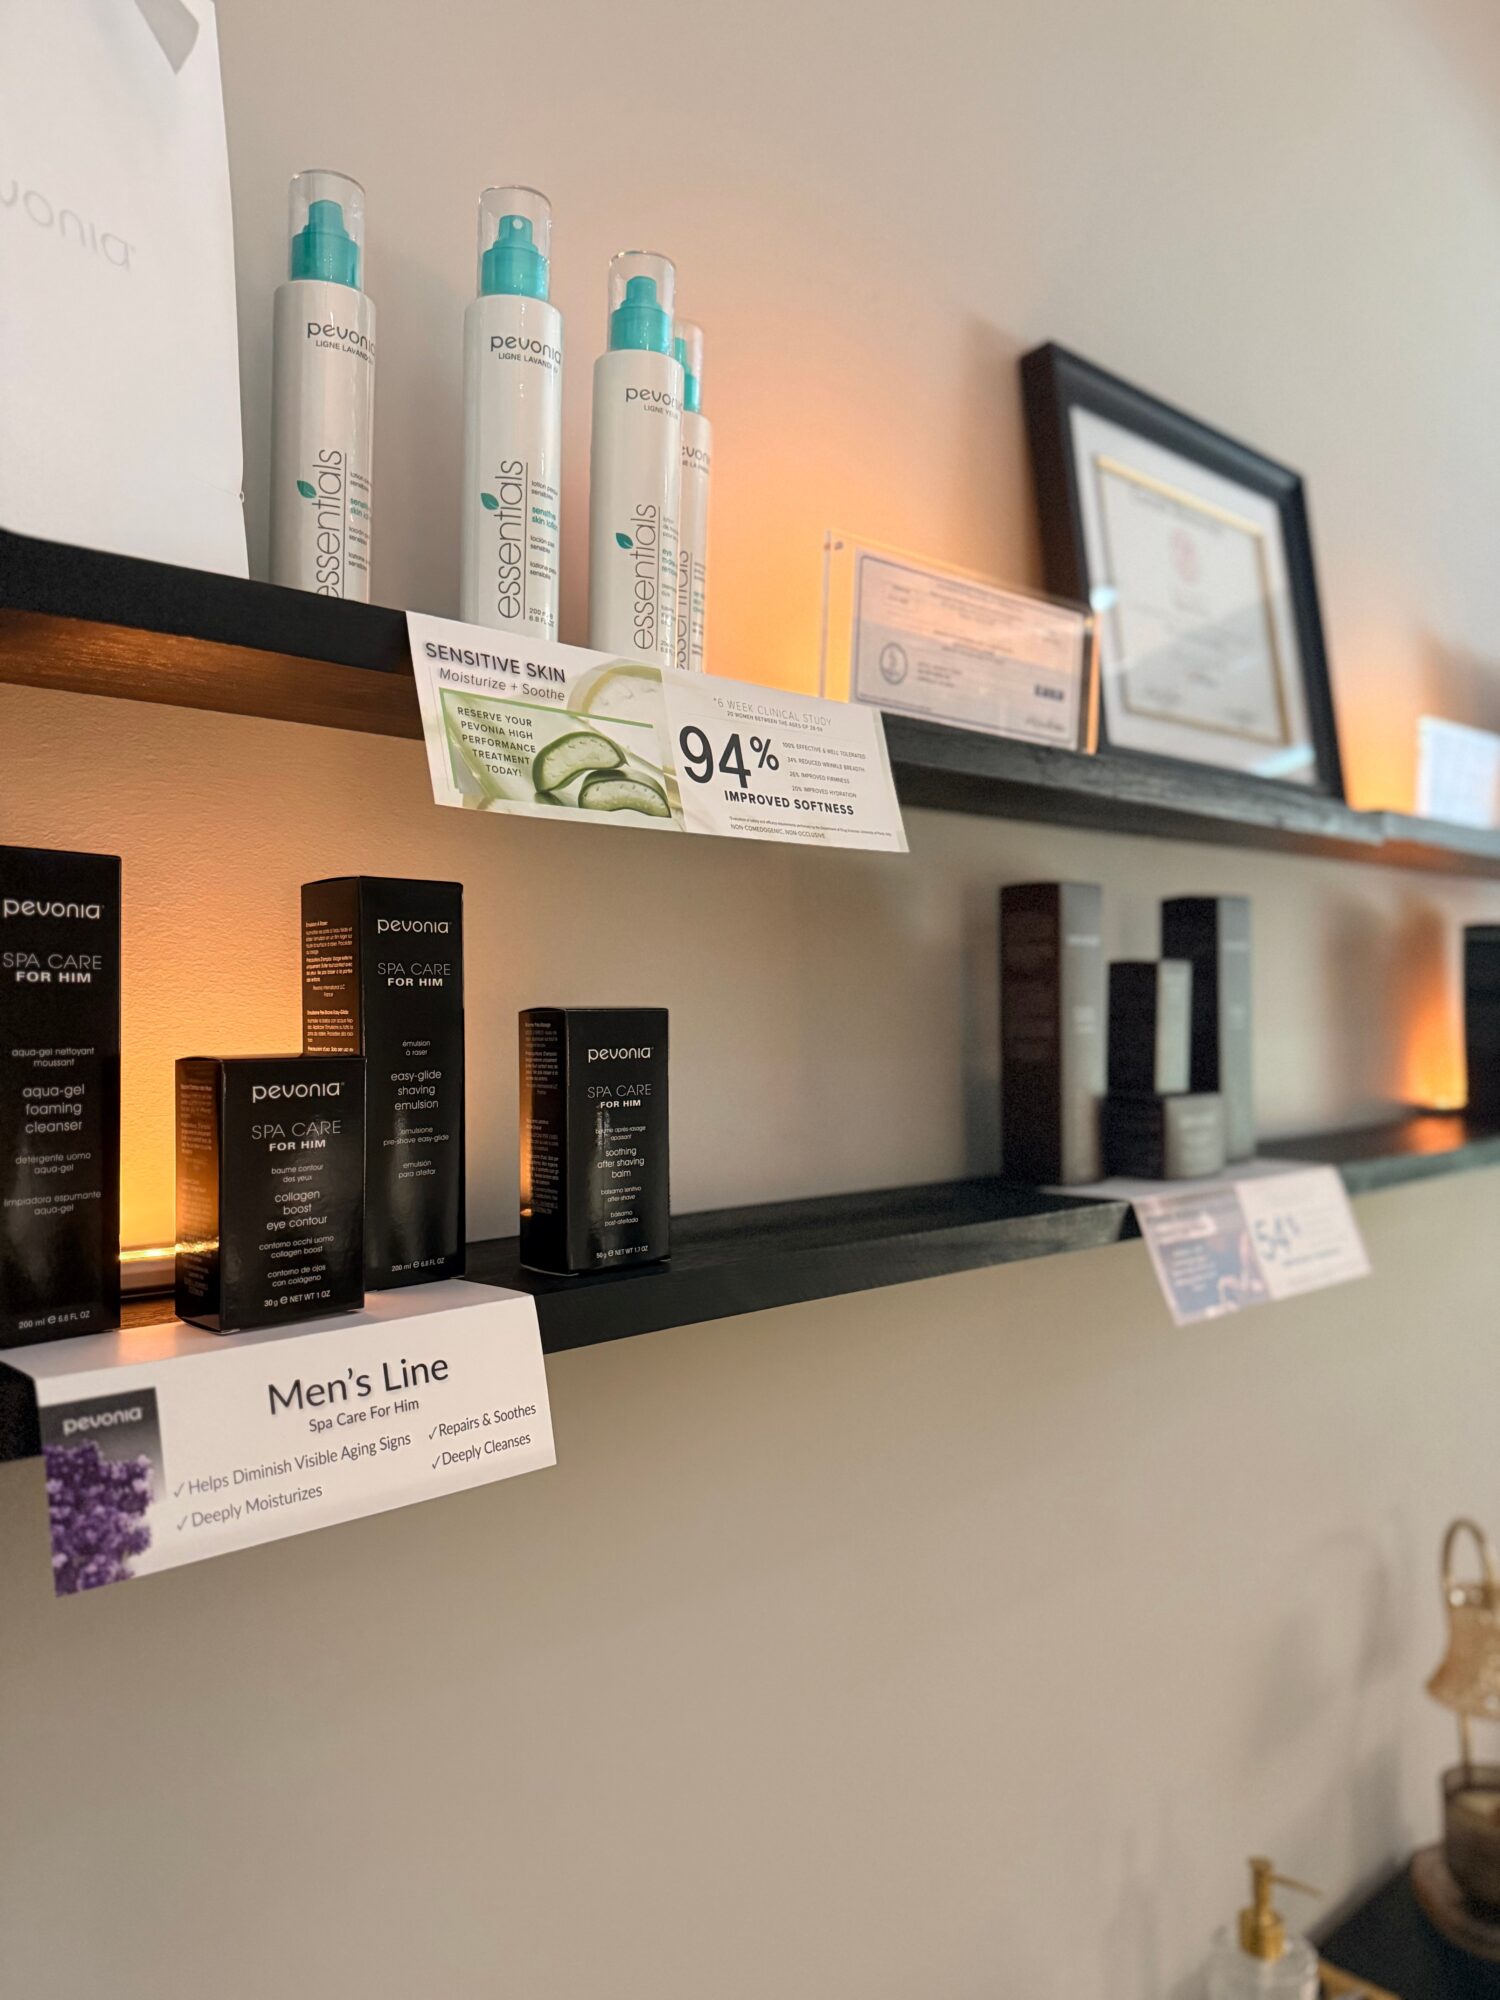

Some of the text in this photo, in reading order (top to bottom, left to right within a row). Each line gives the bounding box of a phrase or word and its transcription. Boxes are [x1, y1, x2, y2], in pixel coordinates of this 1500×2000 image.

[316, 340, 340, 351] LIGNE
[491, 336, 562, 364] pevonia
[644, 404, 663, 414] LIGNE
[532, 516, 545, 525] skin
[494, 460, 523, 618] essentials
[630, 504, 656, 649] essentials
[425, 642, 566, 683] SENSITIVE SKIN
[439, 668, 506, 690] Moisturize
[522, 683, 565, 701] Soothe
[457, 706, 532, 727] RESERVE YOUR
[727, 700, 753, 713] WEEK
[757, 705, 800, 722] CLINICAL
[803, 714, 832, 726] STUDY
[461, 720, 533, 740] PEVONIA HIGH
[462, 734, 536, 753] PERFORMANCE
[472, 748, 530, 765] TREATMENT
[679, 725, 780, 789] 94%
[796, 743, 821, 753] EFFECTIVE
[840, 750, 867, 760] TOLERATED
[799, 758, 822, 767] REDUCED
[486, 764, 522, 777] TODAY!
[801, 772, 826, 781] IMPROVED
[803, 787, 857, 799] IMPROVED HYDRATION
[724, 790, 854, 815] IMPROVED SOFTNESS
[3, 899, 100, 919] pevonia
[377, 919, 449, 934] pevonia
[3, 952, 102, 970] SPA CARE
[377, 962, 451, 976] SPA CARE
[16, 971, 91, 983] FOR HIM
[387, 977, 443, 987] FOR HIM
[11, 1047, 95, 1058] aqua-gel nettoyant
[588, 1047, 651, 1063] pevonia
[33, 1058, 75, 1067] moussant
[390, 1069, 442, 1082] easy-glide
[22, 1084, 85, 1099] aqua-gel
[252, 1082, 340, 1104] pevonia
[397, 1085, 436, 1096] shaving
[587, 1084, 652, 1099] SPA CARE
[25, 1102, 82, 1116] foaming
[394, 1100, 439, 1111] emulsion
[600, 1099, 641, 1109] FOR HIM
[25, 1120, 83, 1134] cleanser
[251, 1120, 341, 1140] SPA CARE
[269, 1139, 326, 1152] FOR HIM
[15, 1152, 92, 1165] detergente uomo
[605, 1148, 637, 1158] soothing
[34, 1164, 74, 1175] aqua-gel
[271, 1164, 324, 1175] baume contour
[597, 1158, 645, 1169] after shaving
[297, 1175, 312, 1183] yeux
[398, 1170, 414, 1179] para
[611, 1169, 631, 1179] balm
[54, 1191, 101, 1203] espumante
[275, 1190, 320, 1203] collagen
[34, 1204, 74, 1216] aqua-gel
[283, 1203, 312, 1215] boost
[266, 1216, 328, 1232] eye contour
[293, 1238, 313, 1246] occhi
[314, 1235, 334, 1244] uomo
[271, 1246, 323, 1259] collagen boost
[614, 1248, 625, 1256] NET
[301, 1266, 310, 1274] de
[289, 1290, 331, 1303] NET WT OZ
[18, 1320, 33, 1330] 200
[35, 1318, 45, 1327] ml
[70, 1313, 78, 1321] FL
[80, 1310, 90, 1319] OZ
[268, 1358, 449, 1415] Men's Line
[62, 1407, 143, 1436] pevonia
[309, 1399, 419, 1434] Spa Care For Him
[438, 1404, 537, 1437] Repairs & Soothes
[442, 1434, 531, 1466] Deeply Cleanses
[188, 1433, 412, 1495] Helps Diminish Visible Aging Signs
[191, 1484, 324, 1528] Deeply Moisturizes
